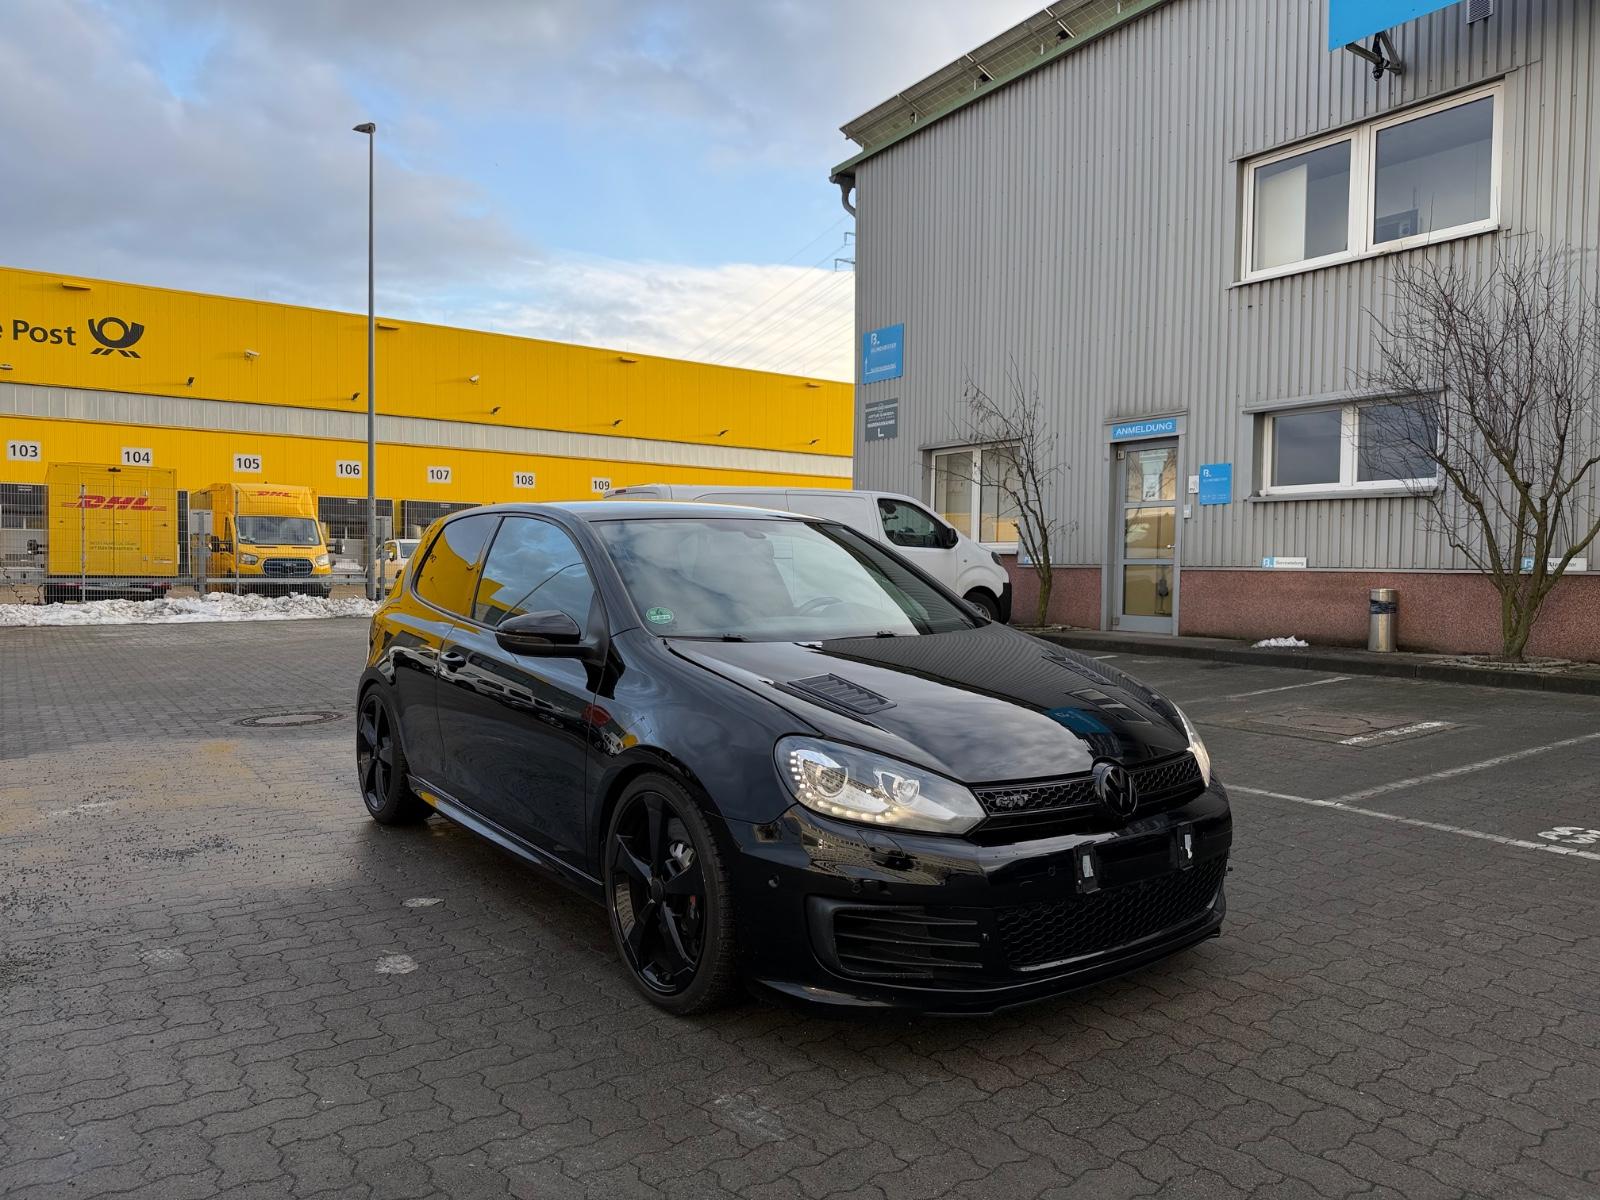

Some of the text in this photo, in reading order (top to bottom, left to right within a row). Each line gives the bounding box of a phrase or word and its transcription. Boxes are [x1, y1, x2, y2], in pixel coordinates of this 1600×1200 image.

[12, 319, 77, 346] Post
[1116, 422, 1173, 436] ANMELDUNG
[10, 444, 38, 458] 103
[124, 451, 151, 464] 104
[236, 457, 260, 470] 105
[338, 463, 360, 475] 106
[429, 469, 450, 481] 107
[515, 474, 534, 486] 108
[593, 480, 610, 490] 109
[75, 495, 155, 511] DHL
